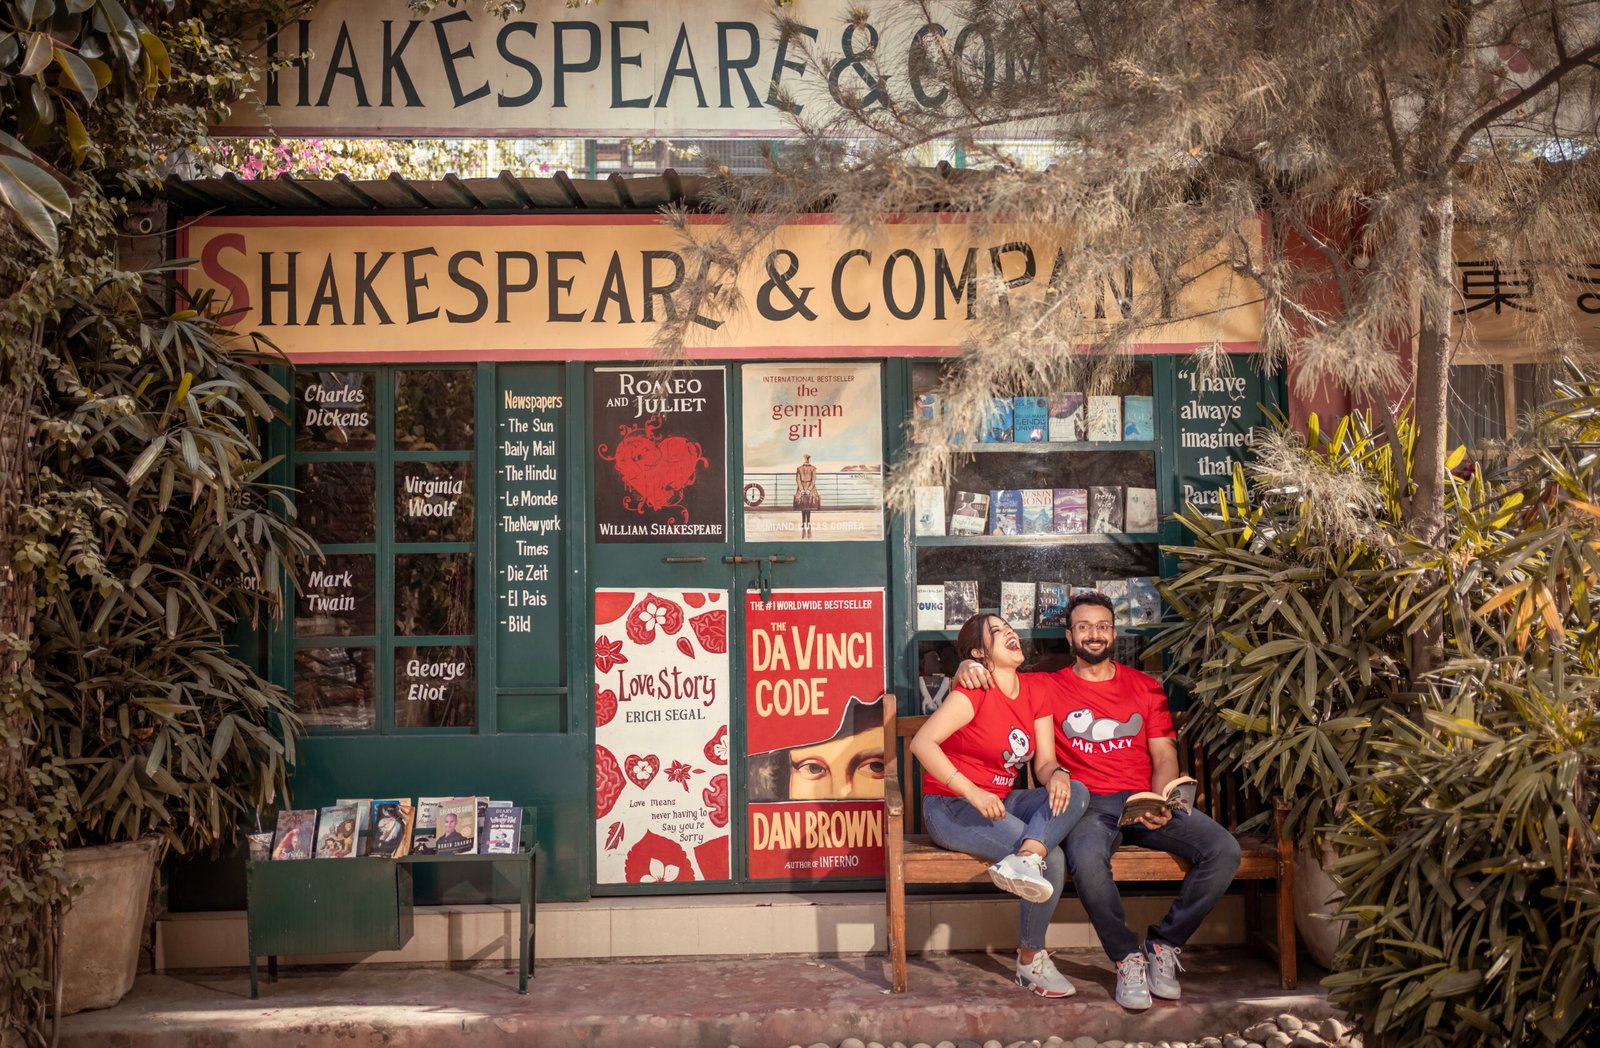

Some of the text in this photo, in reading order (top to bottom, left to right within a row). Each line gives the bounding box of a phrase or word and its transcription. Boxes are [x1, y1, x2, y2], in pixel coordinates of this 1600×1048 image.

[265, 10, 1050, 113] HAKESPEARE & COM
[200, 232, 726, 331] SHAKESPEARE
[756, 248, 819, 322] &
[619, 373, 702, 395] ROMEO
[762, 375, 856, 383] INTERNATIONAL BESTSELLER
[1202, 374, 1247, 392] have
[304, 384, 365, 403] Charles
[796, 384, 818, 397] the
[504, 390, 563, 413] Newspapers
[606, 395, 707, 419] AND JULIET
[305, 408, 369, 427] Dickens
[772, 403, 844, 420] german
[1180, 400, 1242, 427] always
[532, 418, 554, 433] Sun
[788, 419, 823, 442] girl
[1181, 427, 1254, 449] imagined
[533, 441, 556, 457] Mail
[525, 464, 557, 481] Hindu
[1197, 456, 1234, 476] that
[405, 475, 463, 496] Virginia
[521, 490, 558, 506] Monde
[1184, 485, 1255, 505] Paradie
[408, 500, 458, 518] Woolf
[599, 523, 723, 536] WILLIAM SHAKESPEARE
[515, 540, 549, 556] Times
[308, 570, 353, 589] Mark
[525, 564, 549, 581] Zeit
[522, 589, 548, 607] Pais
[1040, 583, 1064, 596] keep
[306, 594, 356, 612] Twain
[750, 601, 765, 611] THE
[778, 601, 823, 610] WORLDWIDE
[824, 600, 872, 609] BESTSELLER
[1039, 597, 1058, 607] you
[1039, 606, 1064, 616] close
[771, 622, 787, 632] THE
[752, 625, 873, 672] DA VINCI
[406, 660, 466, 681] George
[407, 683, 447, 701] Eliot
[618, 666, 717, 706] Love Story
[755, 677, 830, 717] CODE
[625, 708, 706, 724] ERICH SEGAL
[1100, 738, 1133, 754] LAZY
[629, 799, 646, 808] Love
[651, 807, 708, 822] never having to
[753, 811, 883, 850] DAN BROWN
[784, 855, 859, 870] AUTHOR OF INFERNO
